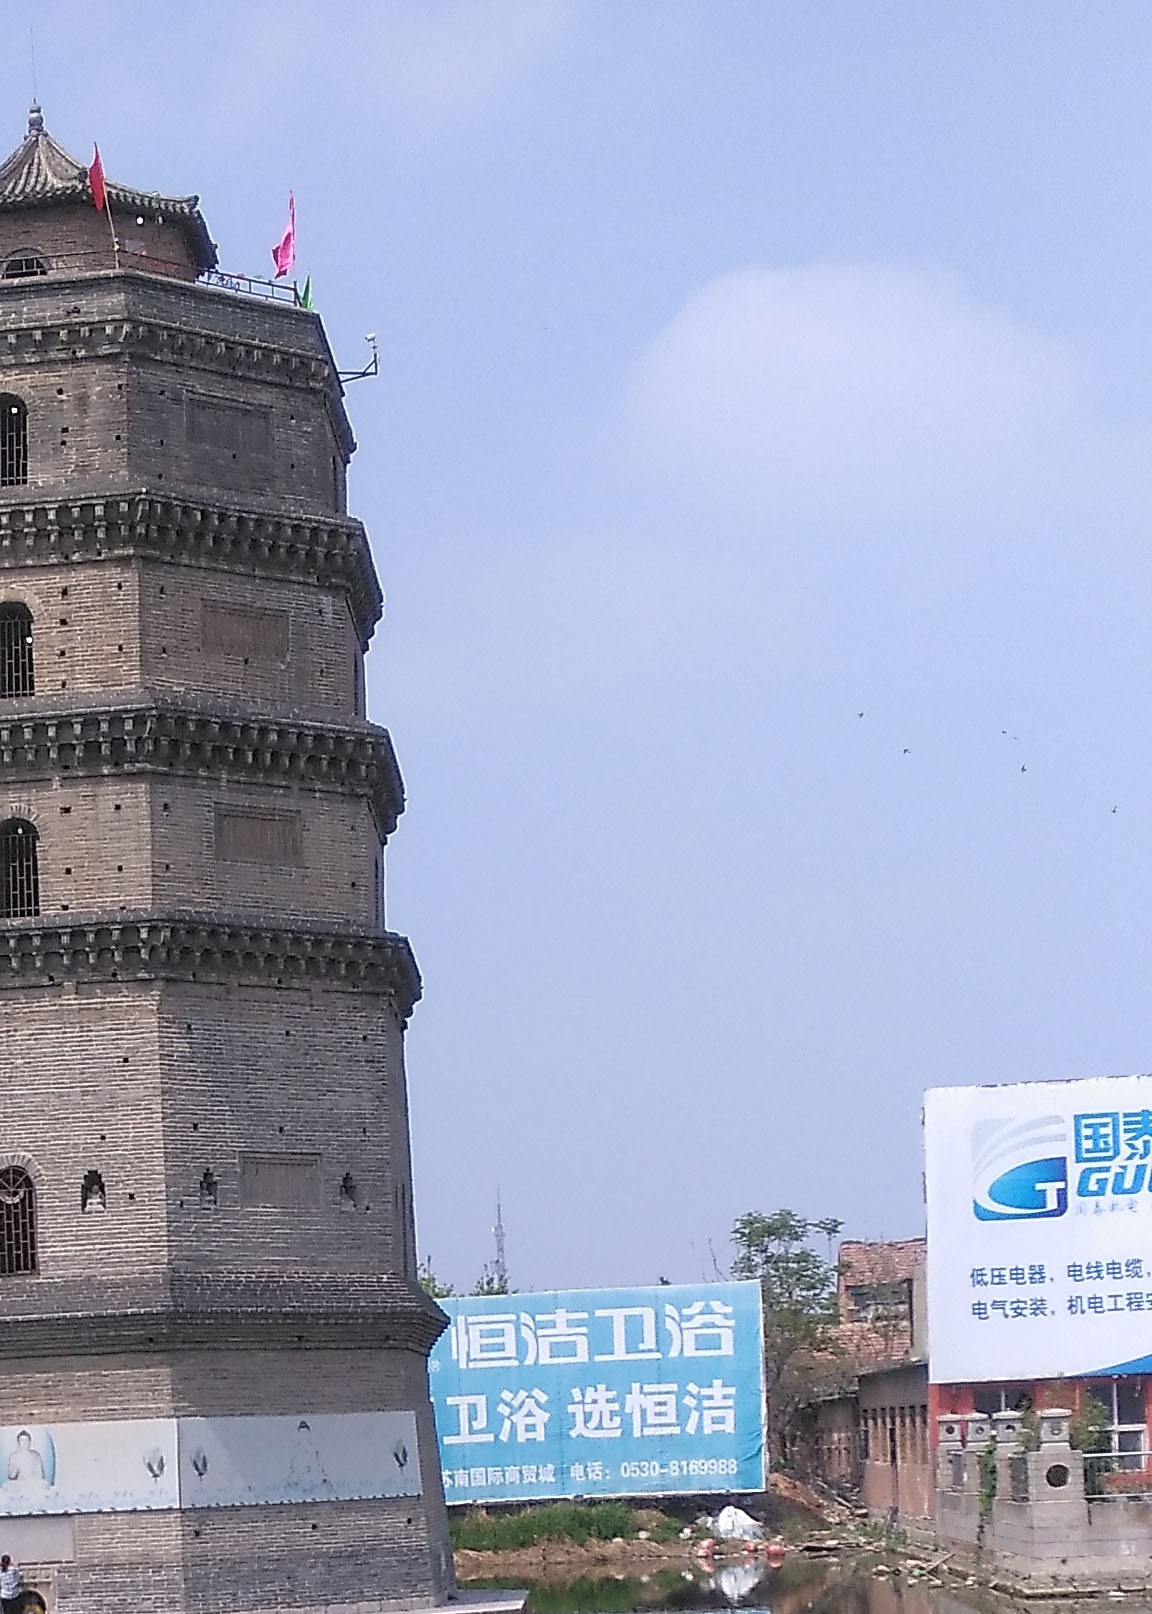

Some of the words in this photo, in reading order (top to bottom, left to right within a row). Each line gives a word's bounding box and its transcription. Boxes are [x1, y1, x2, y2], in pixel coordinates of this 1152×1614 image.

[451, 1300, 735, 1369] 恒洁卫浴
[443, 1387, 550, 1445] 卫浴
[567, 1379, 737, 1439] 选恒洁
